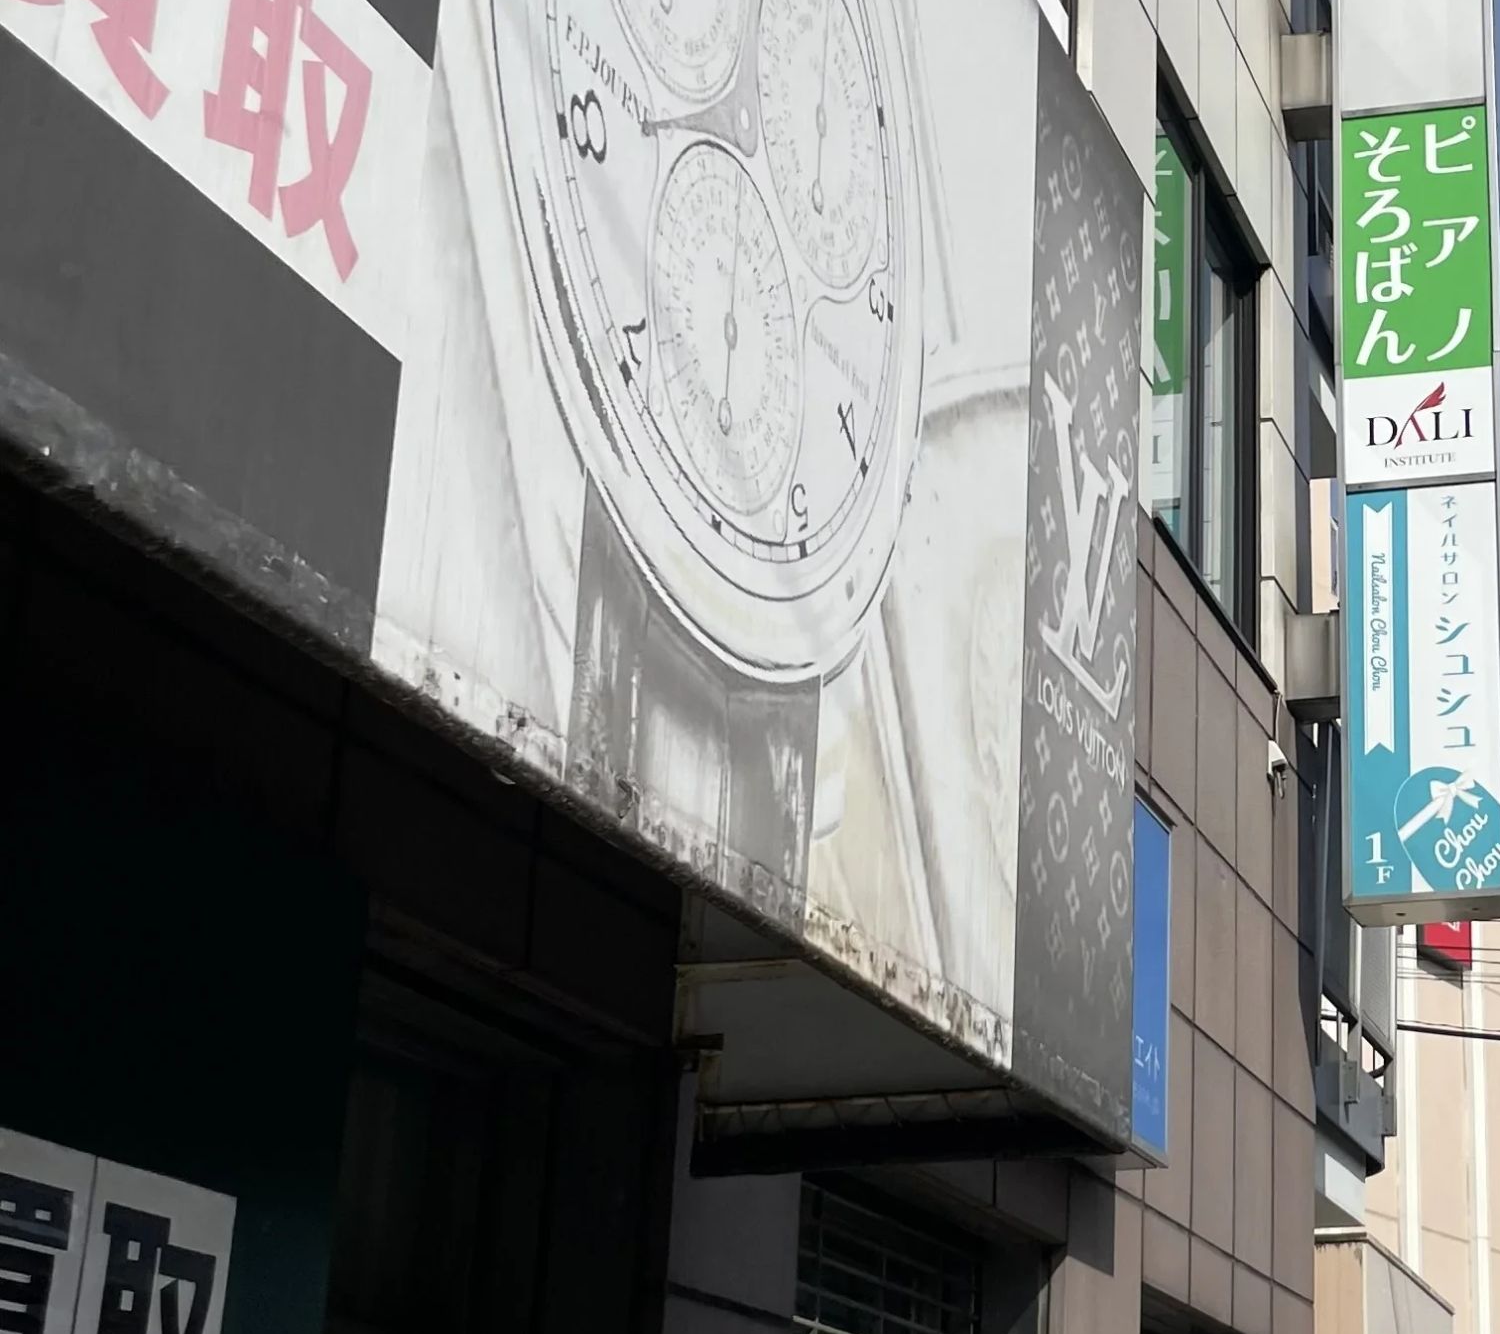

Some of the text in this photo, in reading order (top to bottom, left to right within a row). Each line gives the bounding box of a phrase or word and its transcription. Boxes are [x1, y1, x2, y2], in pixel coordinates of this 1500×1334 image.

[570, 88, 607, 165] 8
[1353, 126, 1418, 366] そろばん
[1422, 116, 1480, 363] ピアノ
[1365, 402, 1475, 449] DALI
[1384, 452, 1457, 468] INSTITUTE
[1369, 617, 1388, 655] Chou
[1435, 495, 1476, 749] ネイルサロン シュシュ
[1369, 657, 1389, 692] Chou
[1036, 667, 1126, 794] LOUIS VUITTON
[1434, 812, 1489, 868] Chou
